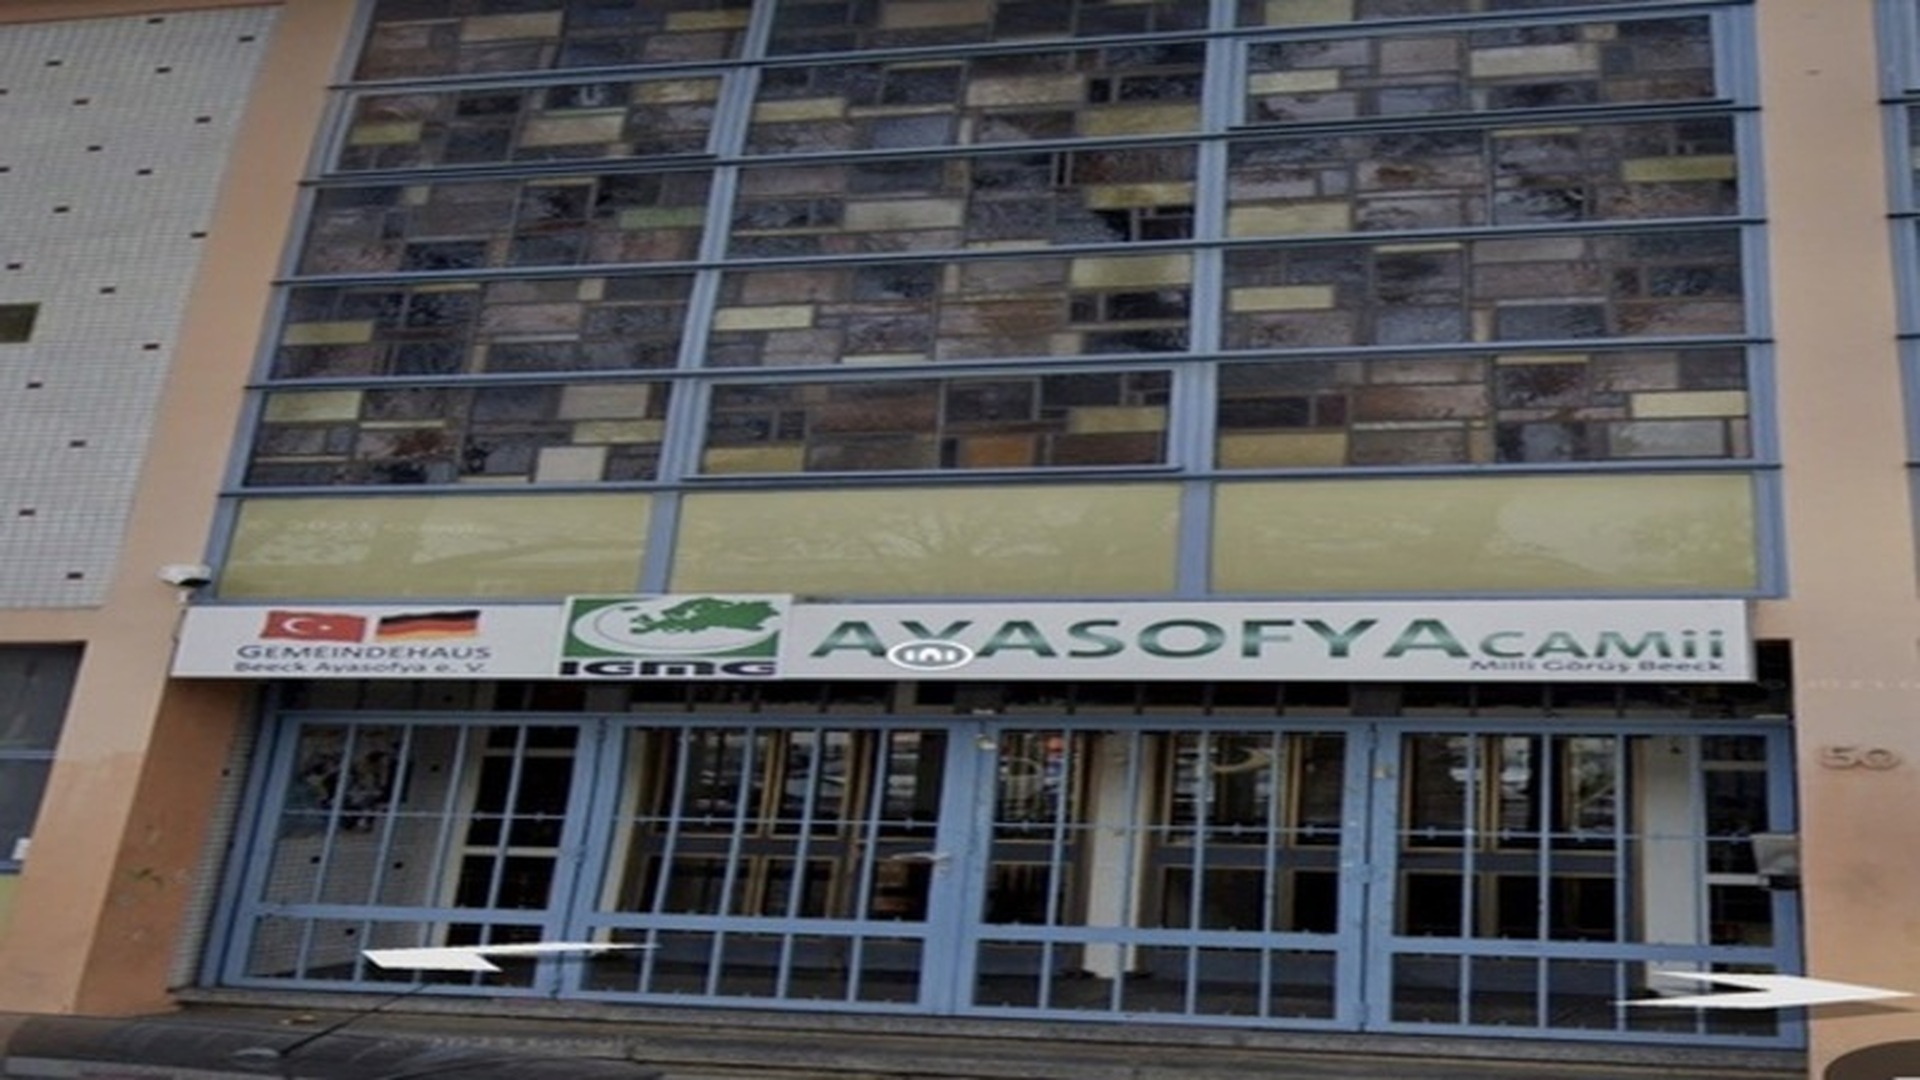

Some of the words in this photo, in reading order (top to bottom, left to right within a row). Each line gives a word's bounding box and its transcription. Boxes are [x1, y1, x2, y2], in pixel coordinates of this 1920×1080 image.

[236, 645, 492, 659] GEMEINDEHAUS
[233, 661, 305, 673] Beeck
[313, 661, 428, 674] Ayasofya
[560, 660, 777, 676] IGMG
[1638, 660, 1723, 672] Beeck
[1817, 747, 1902, 771] 50
